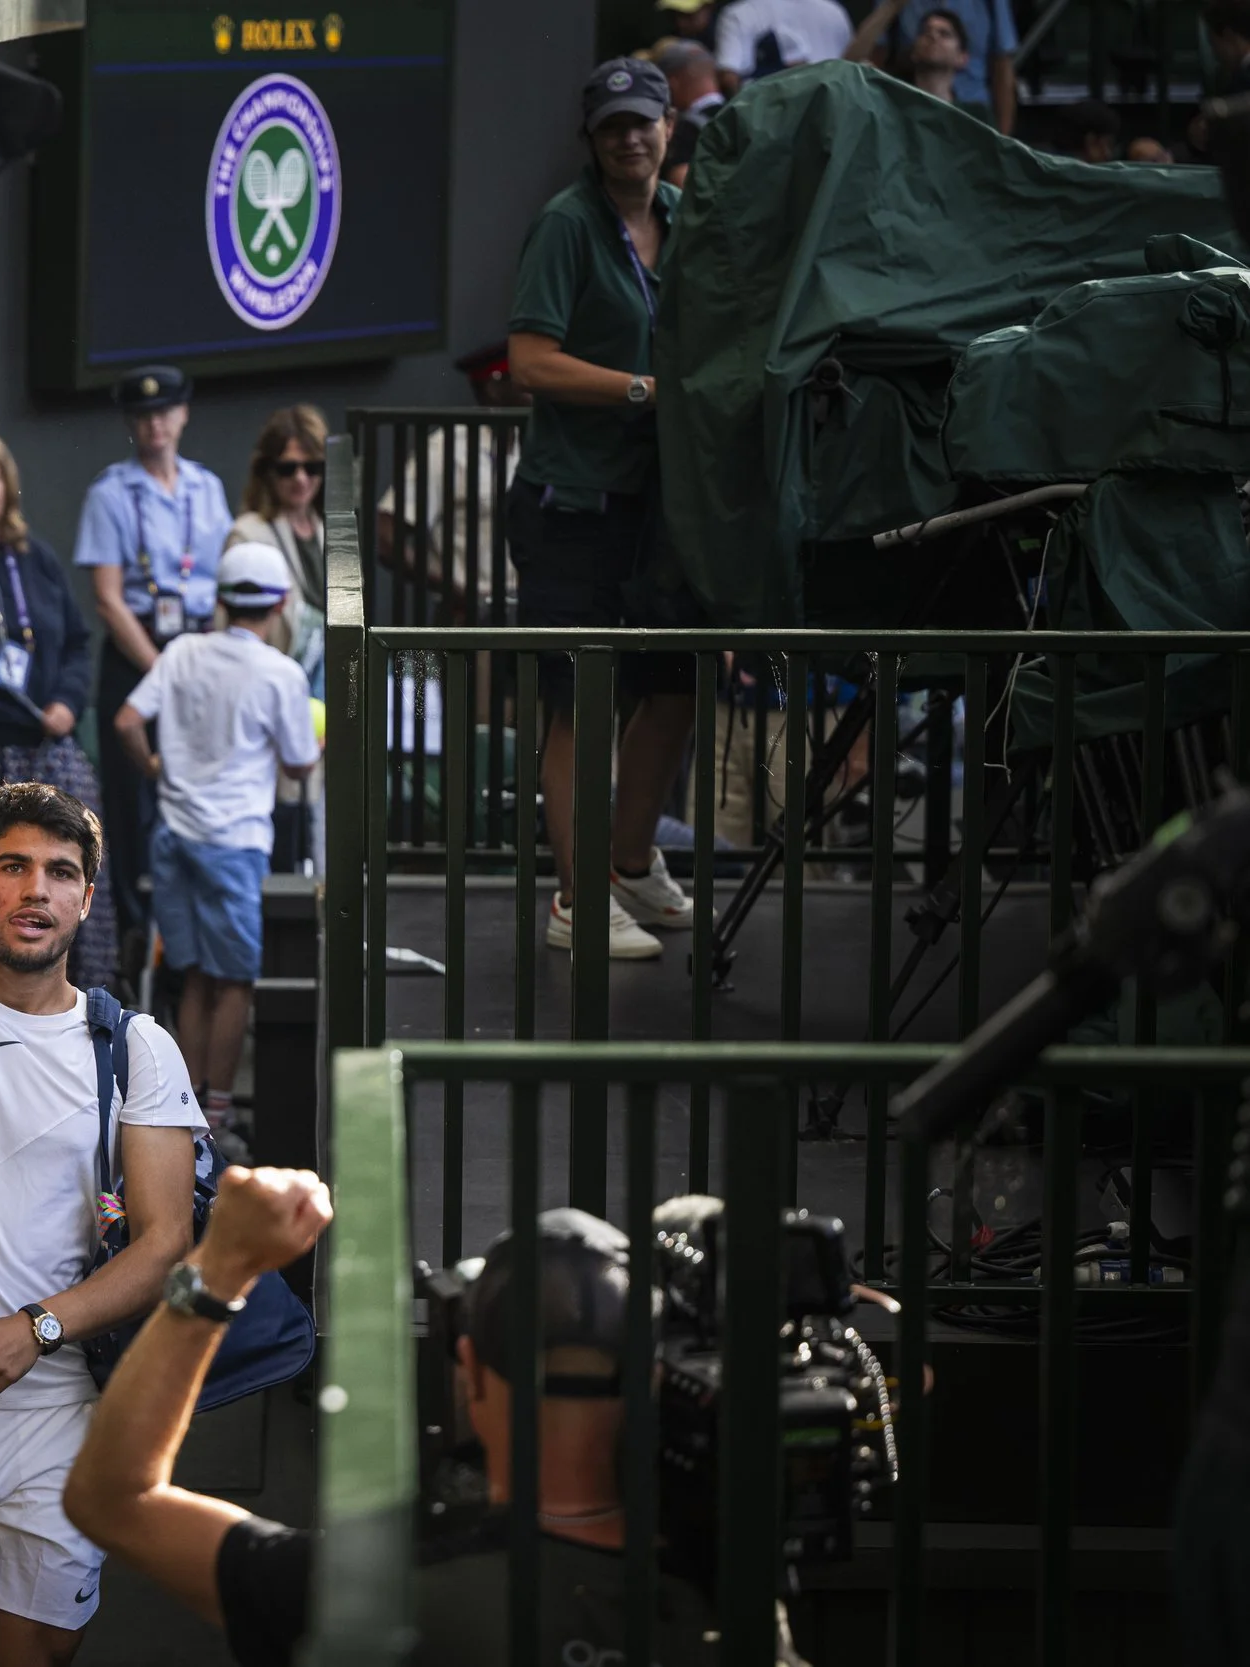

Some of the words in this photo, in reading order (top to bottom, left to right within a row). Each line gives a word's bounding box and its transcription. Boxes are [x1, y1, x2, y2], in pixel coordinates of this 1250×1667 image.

[241, 20, 316, 50] ROLEX
[215, 142, 238, 197] THE
[232, 89, 333, 193] CHAMPIONSHIPS
[230, 259, 318, 315] WIMBLEDON
